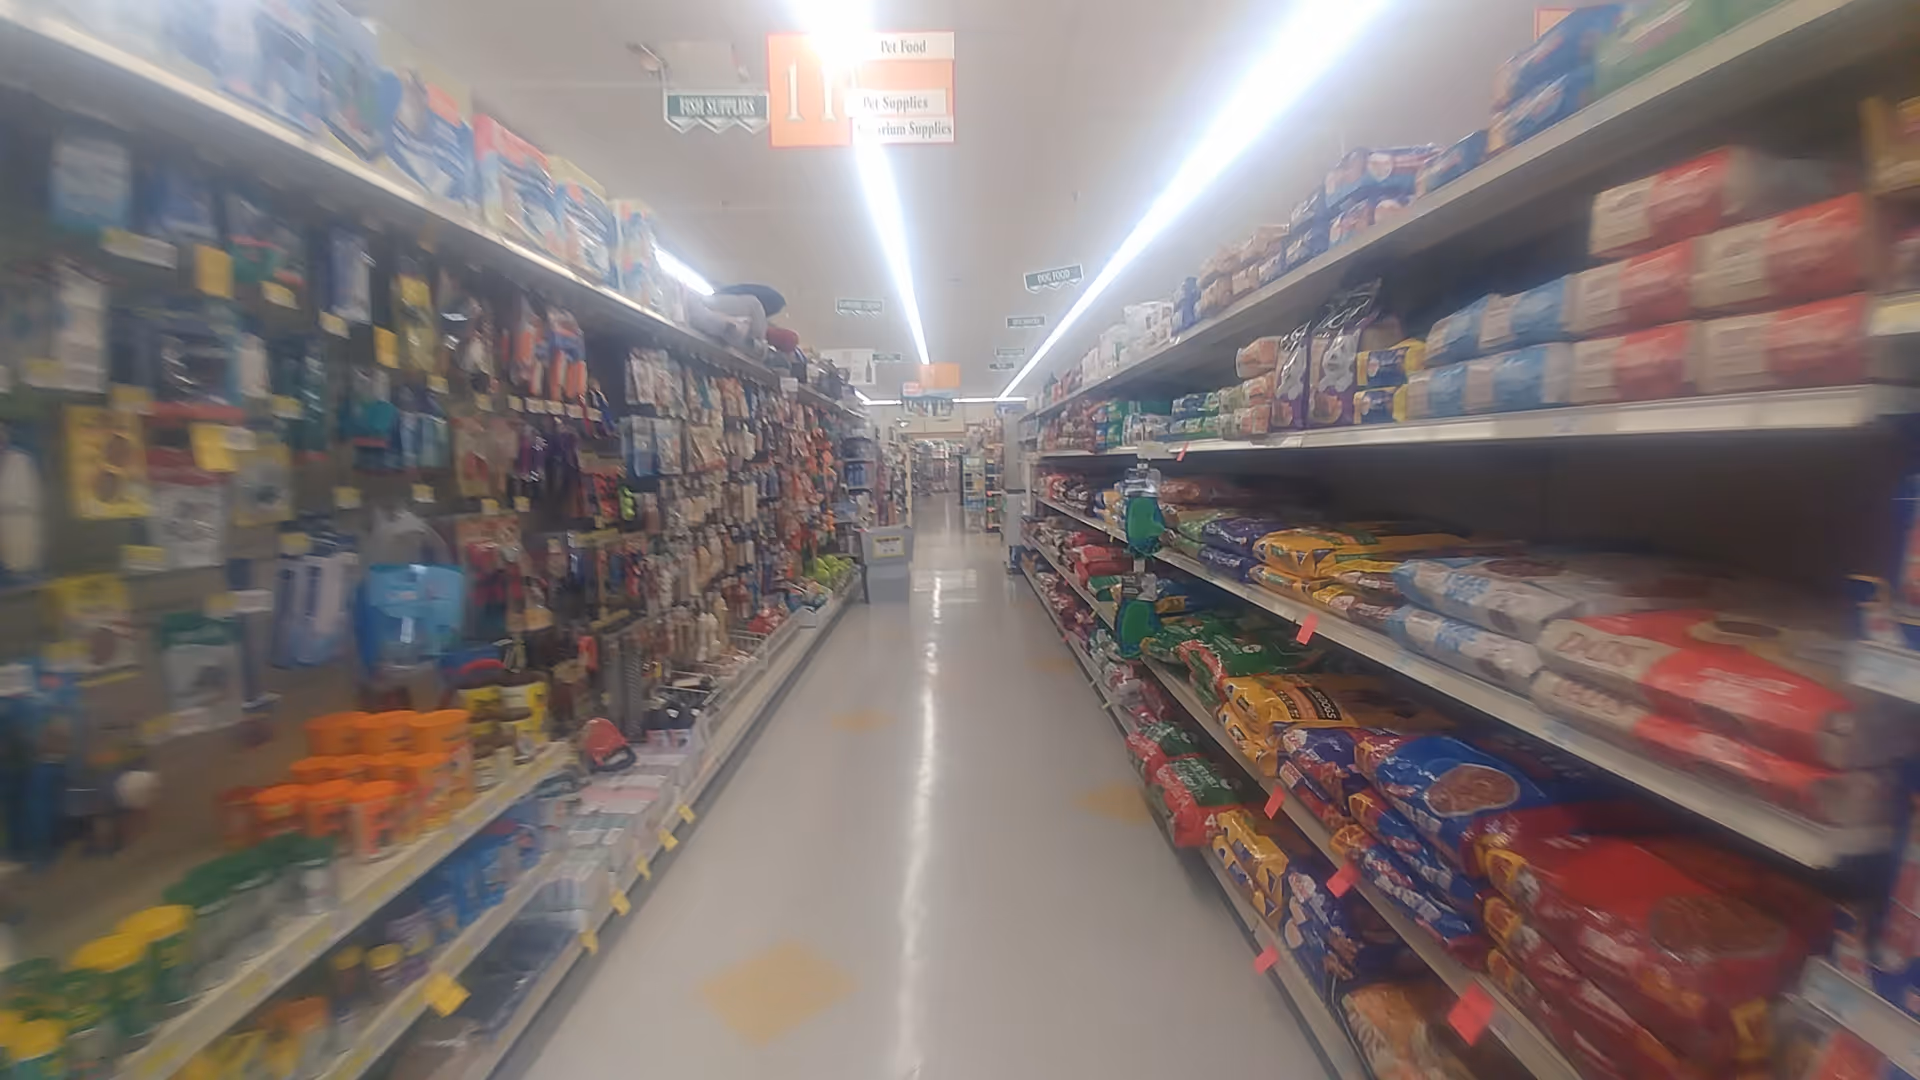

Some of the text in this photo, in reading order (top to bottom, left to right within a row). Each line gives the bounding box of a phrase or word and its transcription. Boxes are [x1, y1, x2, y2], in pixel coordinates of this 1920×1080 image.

[881, 40, 927, 54] Pet Food
[679, 96, 755, 116] FISH SUPPLIES
[863, 95, 929, 112] Pet Supplies
[909, 121, 953, 139] Supplies
[1037, 267, 1071, 284] DOG FOOD
[1205, 814, 1217, 827] 4
